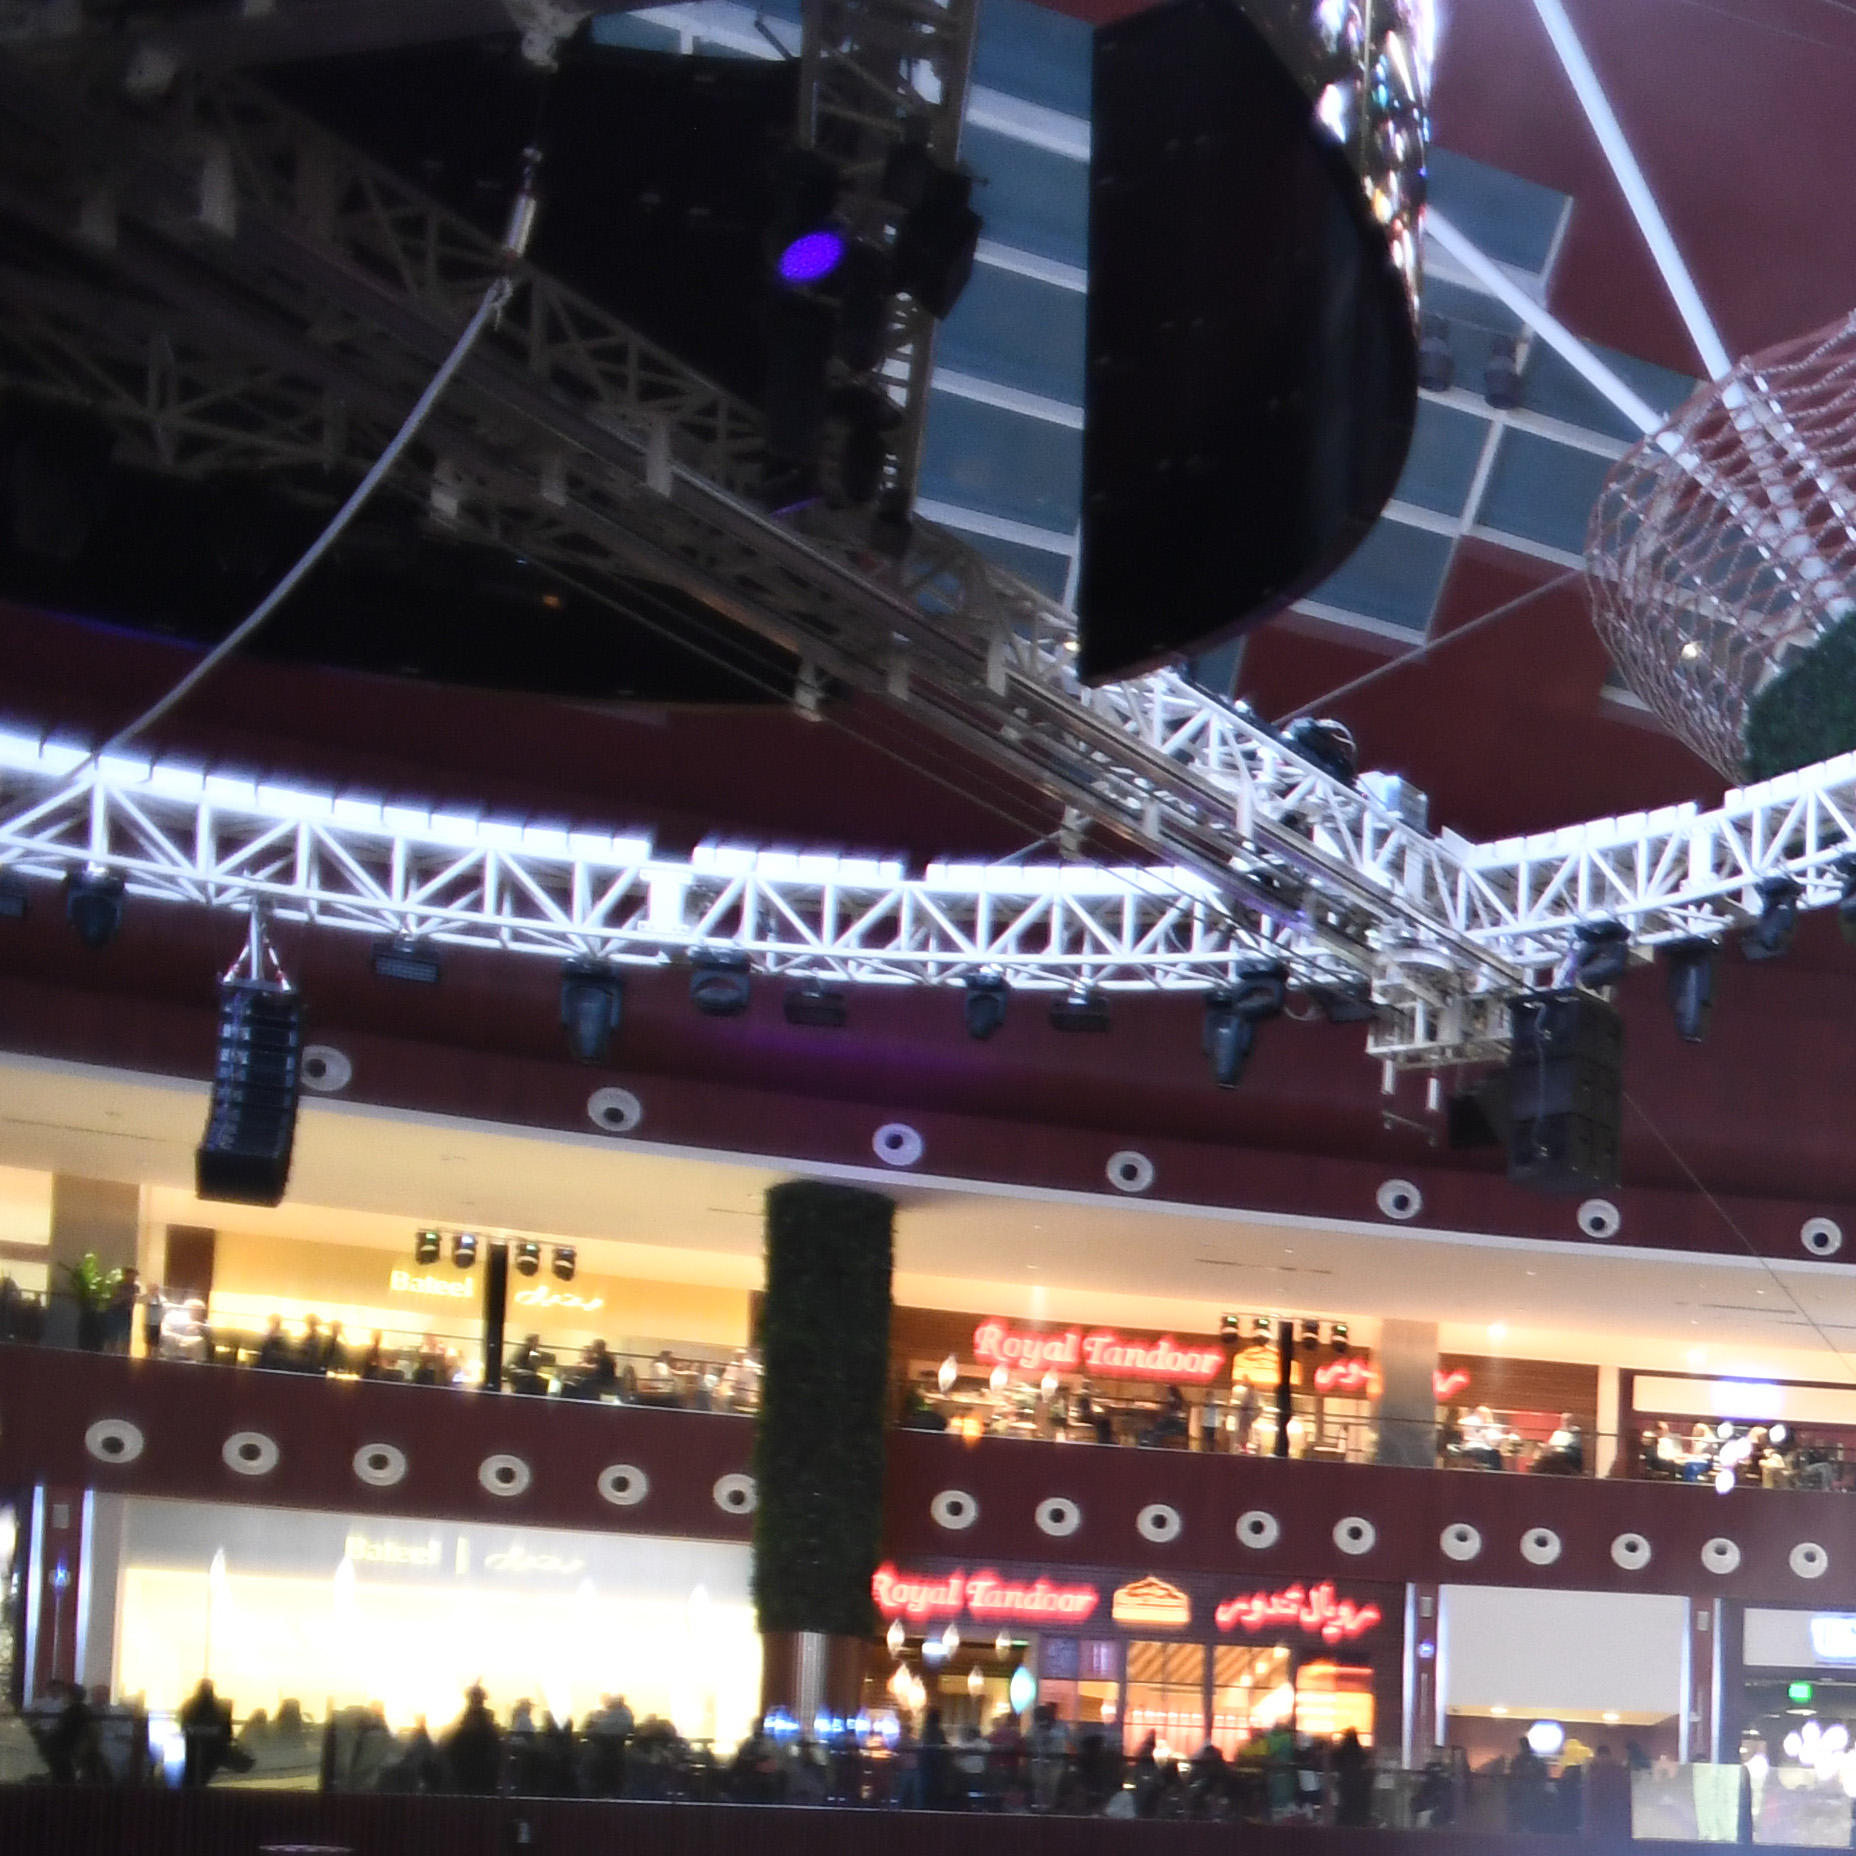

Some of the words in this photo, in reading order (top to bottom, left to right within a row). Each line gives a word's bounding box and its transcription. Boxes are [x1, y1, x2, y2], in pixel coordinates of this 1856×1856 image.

[390, 1270, 474, 1298] Bateel
[974, 1322, 1080, 1370] Royal
[1083, 1334, 1222, 1376] Tandoor
[873, 1570, 964, 1613] Royal
[965, 1578, 1097, 1614] Tandoor
